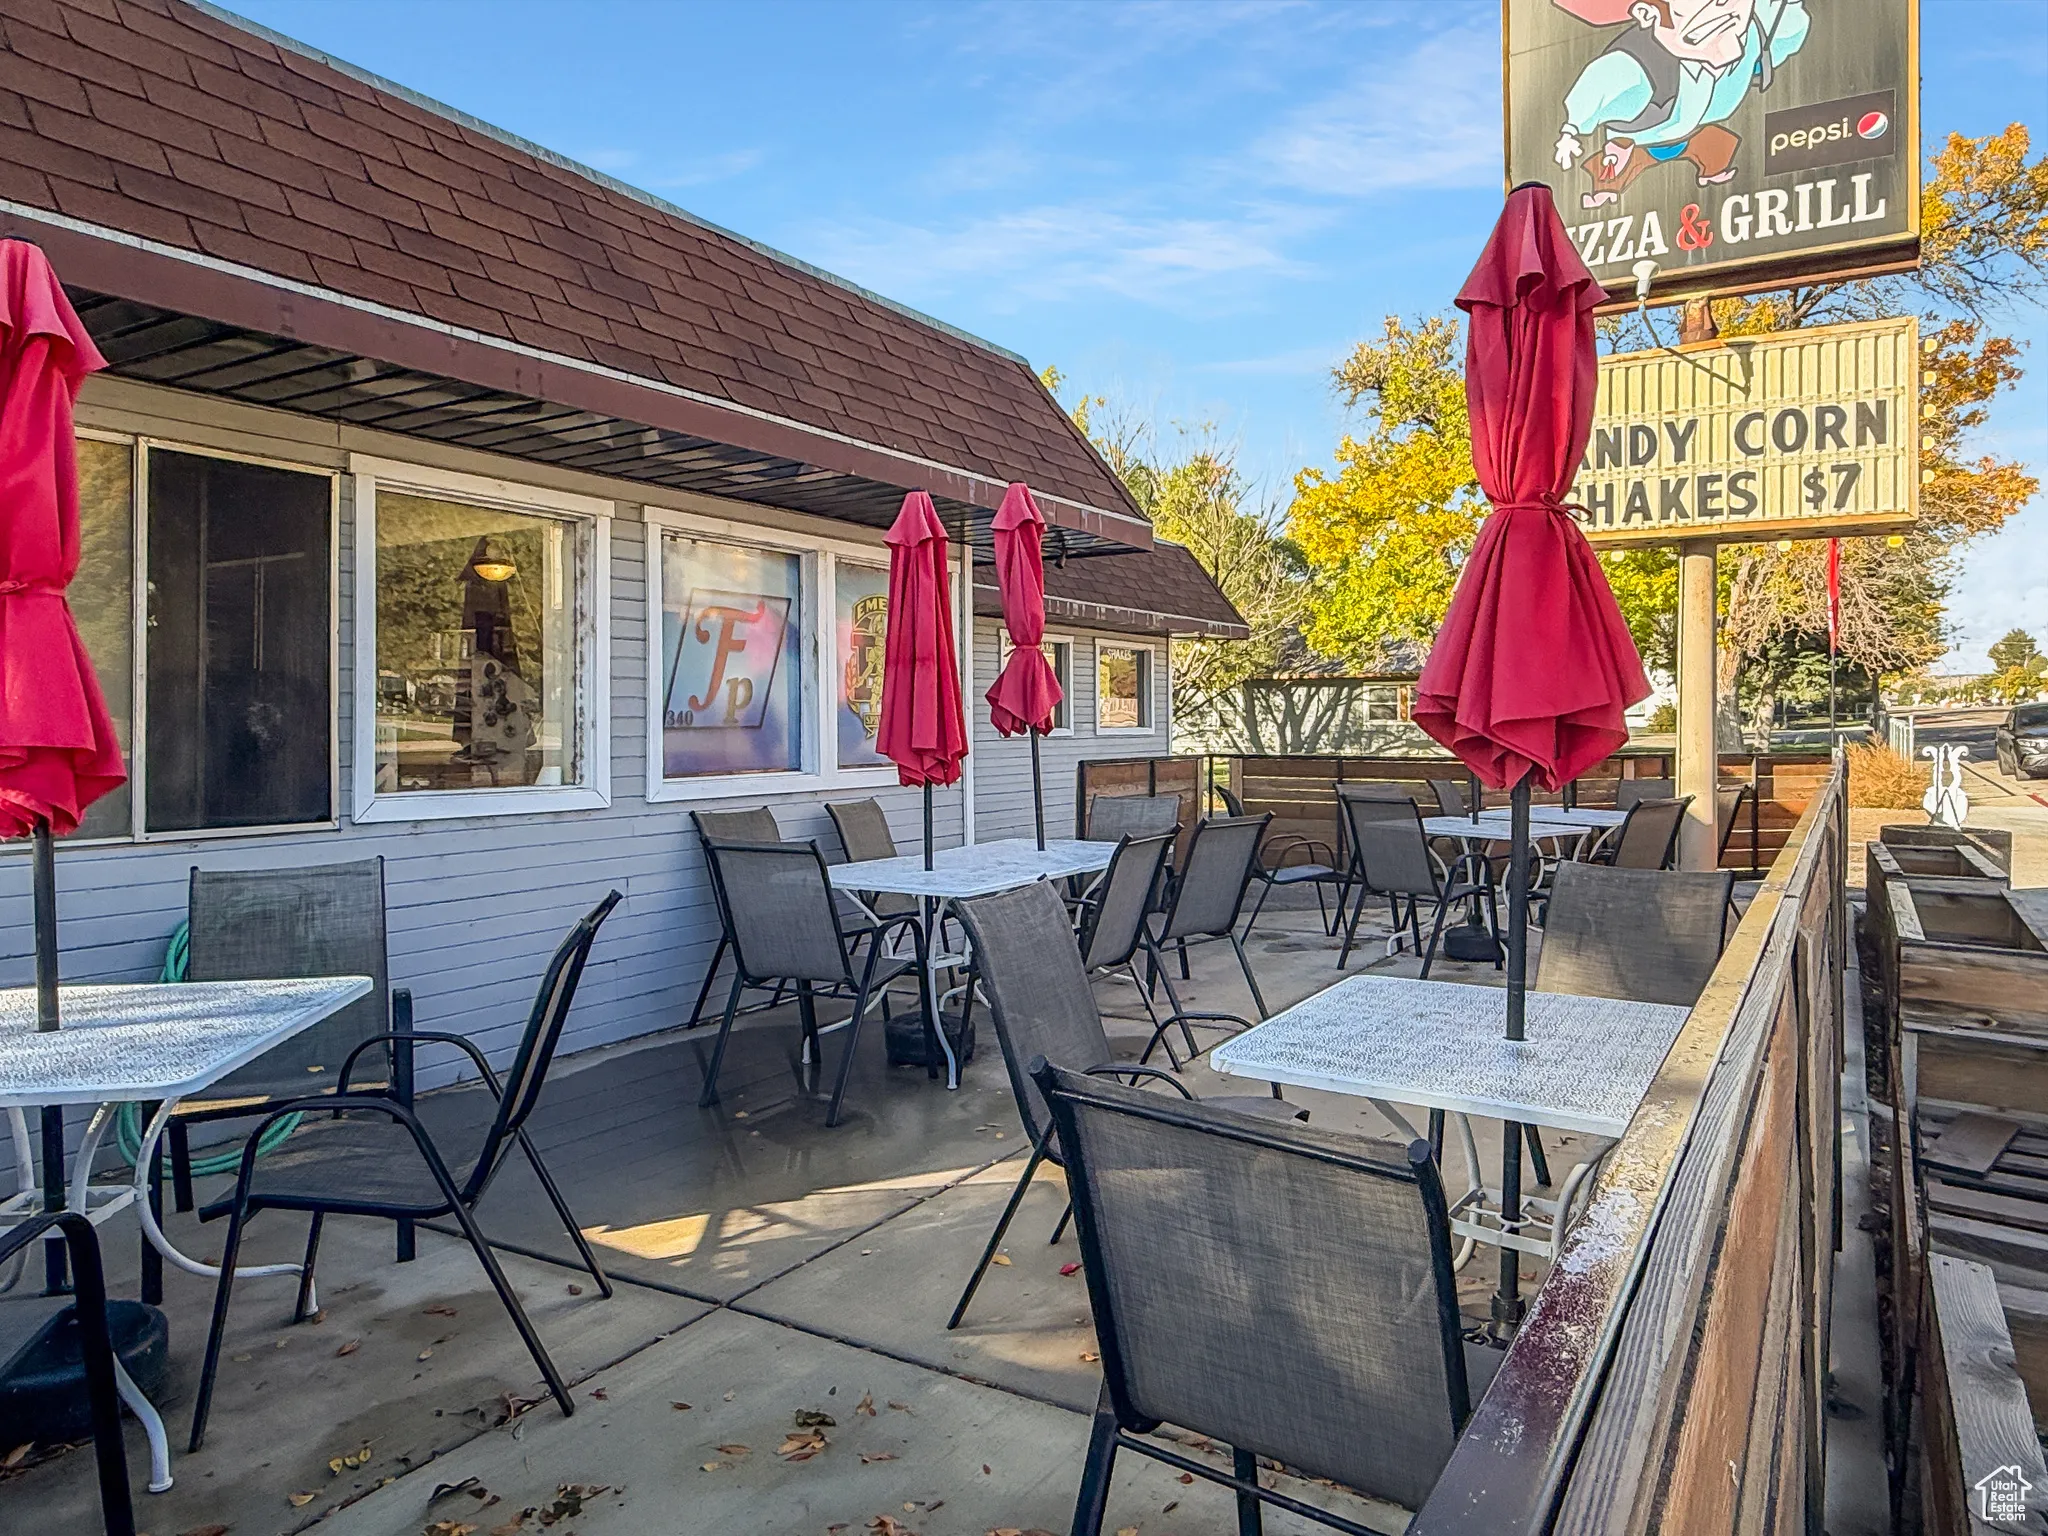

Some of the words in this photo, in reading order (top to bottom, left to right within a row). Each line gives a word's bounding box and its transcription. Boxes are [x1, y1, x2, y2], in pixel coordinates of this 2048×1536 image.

[1566, 210, 1669, 267] ZZA
[1675, 203, 1714, 251] &
[1719, 173, 1887, 244] GRILL
[1580, 418, 1698, 471] NDY
[1733, 399, 1888, 457] CORN
[1571, 470, 1759, 526] HAKES
[1803, 462, 1862, 510] $7
[666, 709, 694, 726] 340
